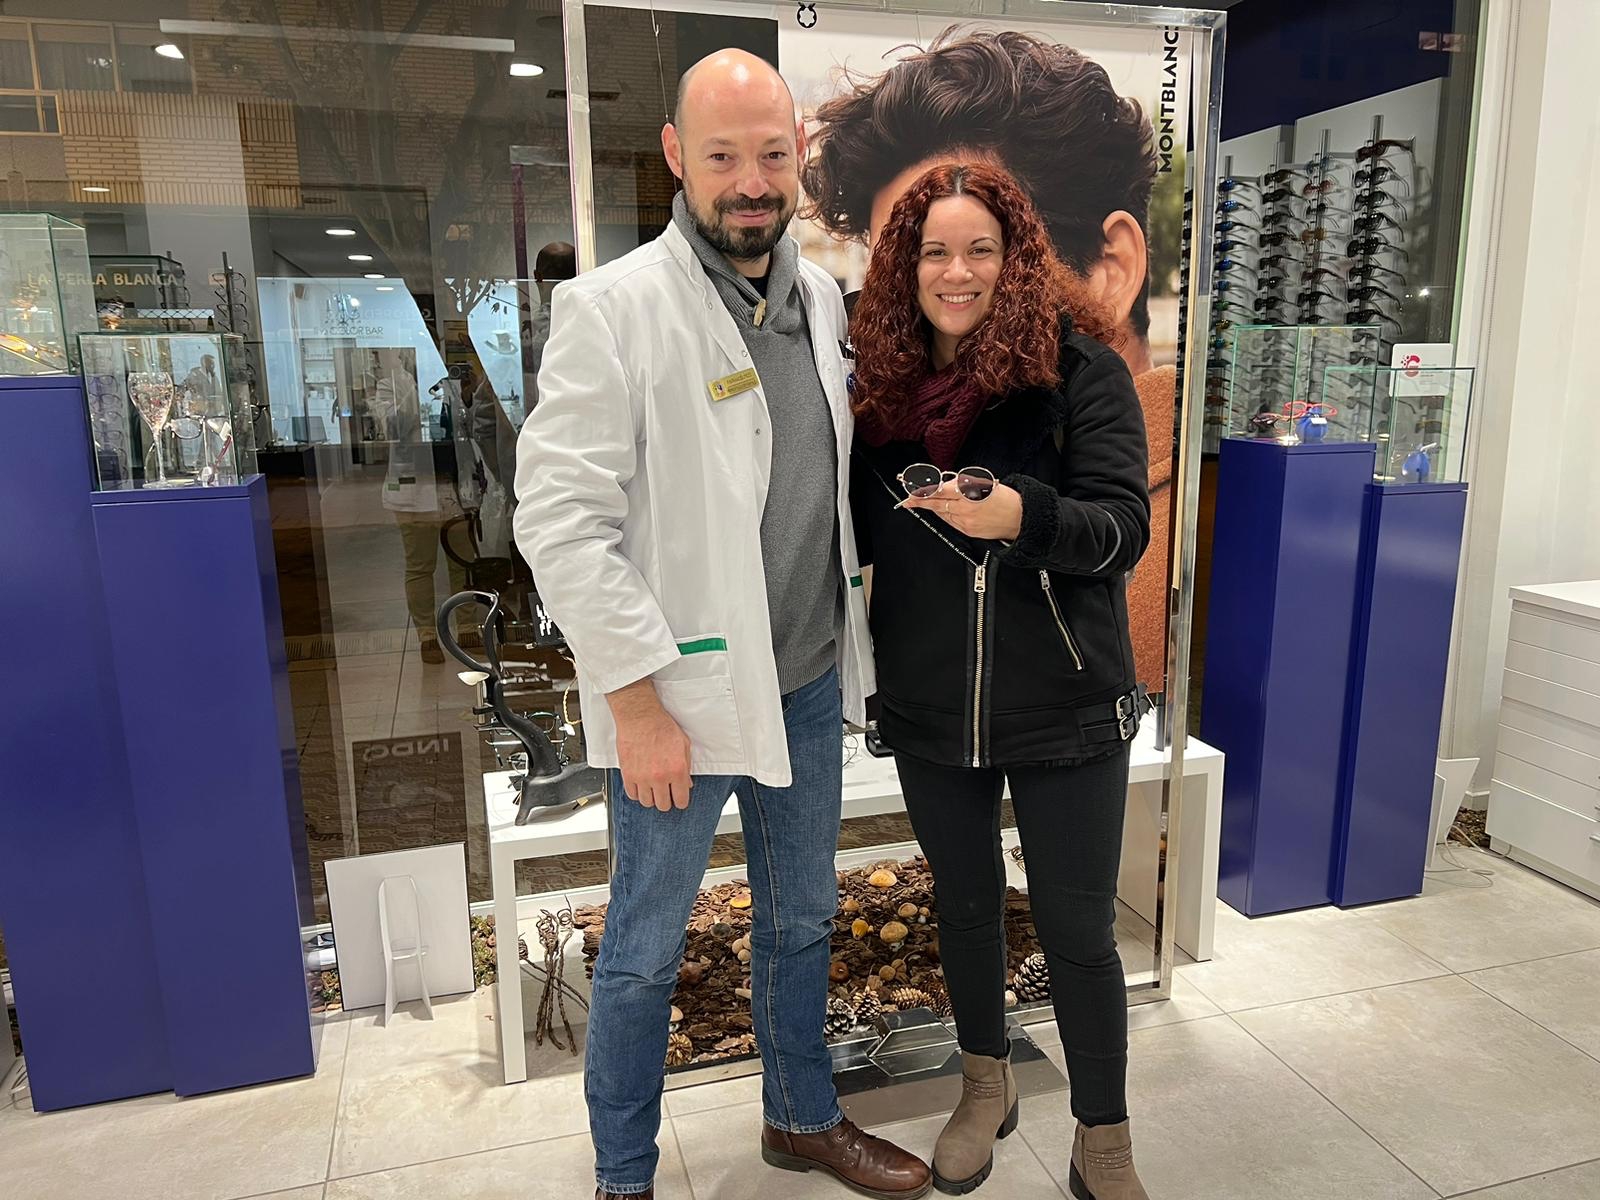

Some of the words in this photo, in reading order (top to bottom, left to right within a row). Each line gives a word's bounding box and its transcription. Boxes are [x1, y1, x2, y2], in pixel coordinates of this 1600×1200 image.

[1158, 28, 1179, 173] MONTBLANC
[60, 273, 107, 286] PERLA
[113, 273, 178, 286] BLANCA
[365, 326, 384, 335] BAR
